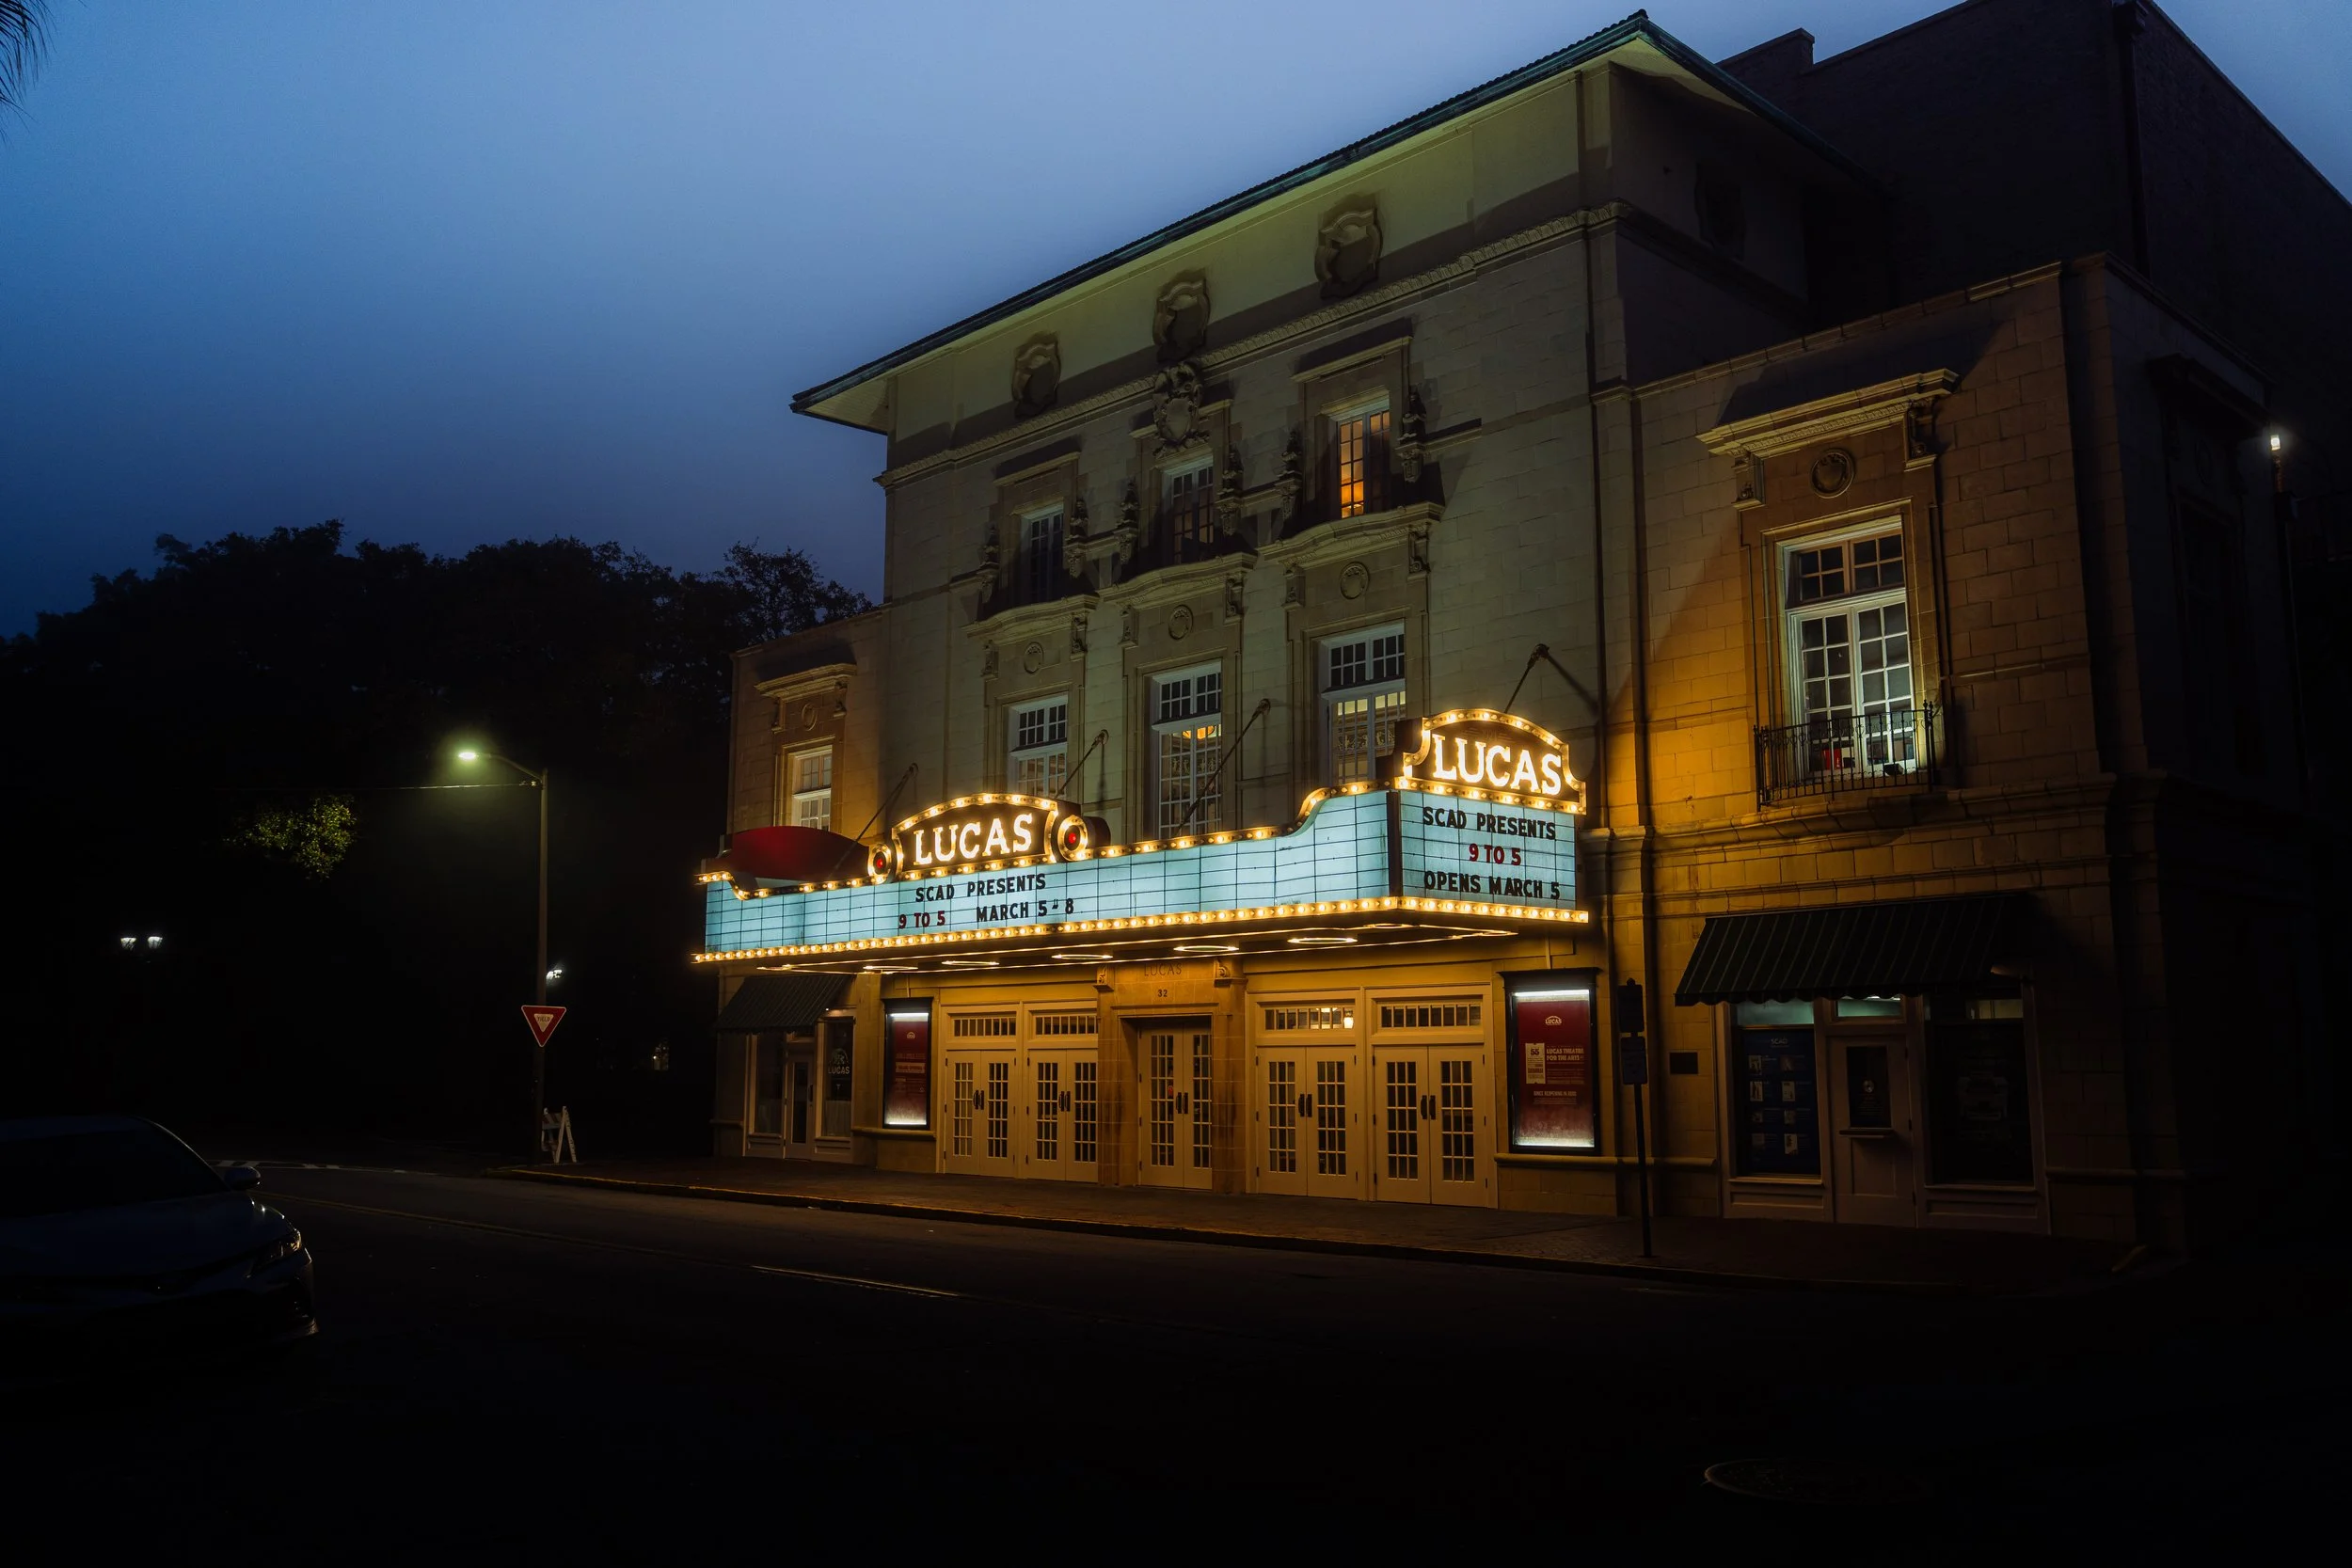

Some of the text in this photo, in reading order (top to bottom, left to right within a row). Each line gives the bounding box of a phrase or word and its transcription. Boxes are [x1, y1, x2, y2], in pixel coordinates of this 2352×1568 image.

[1432, 734, 1562, 795] LUCAS
[1422, 806, 1556, 840] SCAD PRESENTS
[914, 813, 1034, 866] LUCAS
[1469, 843, 1521, 866] 9 TO 5
[915, 873, 1046, 902] SCAD PRESENTS
[1423, 870, 1560, 900] OPENS MARCH 5
[898, 913, 907, 929] 9
[914, 911, 930, 927] TO
[937, 911, 946, 927] 5
[976, 901, 1029, 923] MARCH
[1144, 963, 1183, 976] LUCAS
[1157, 989, 1168, 998] 32
[828, 1066, 850, 1074] LUCAS
